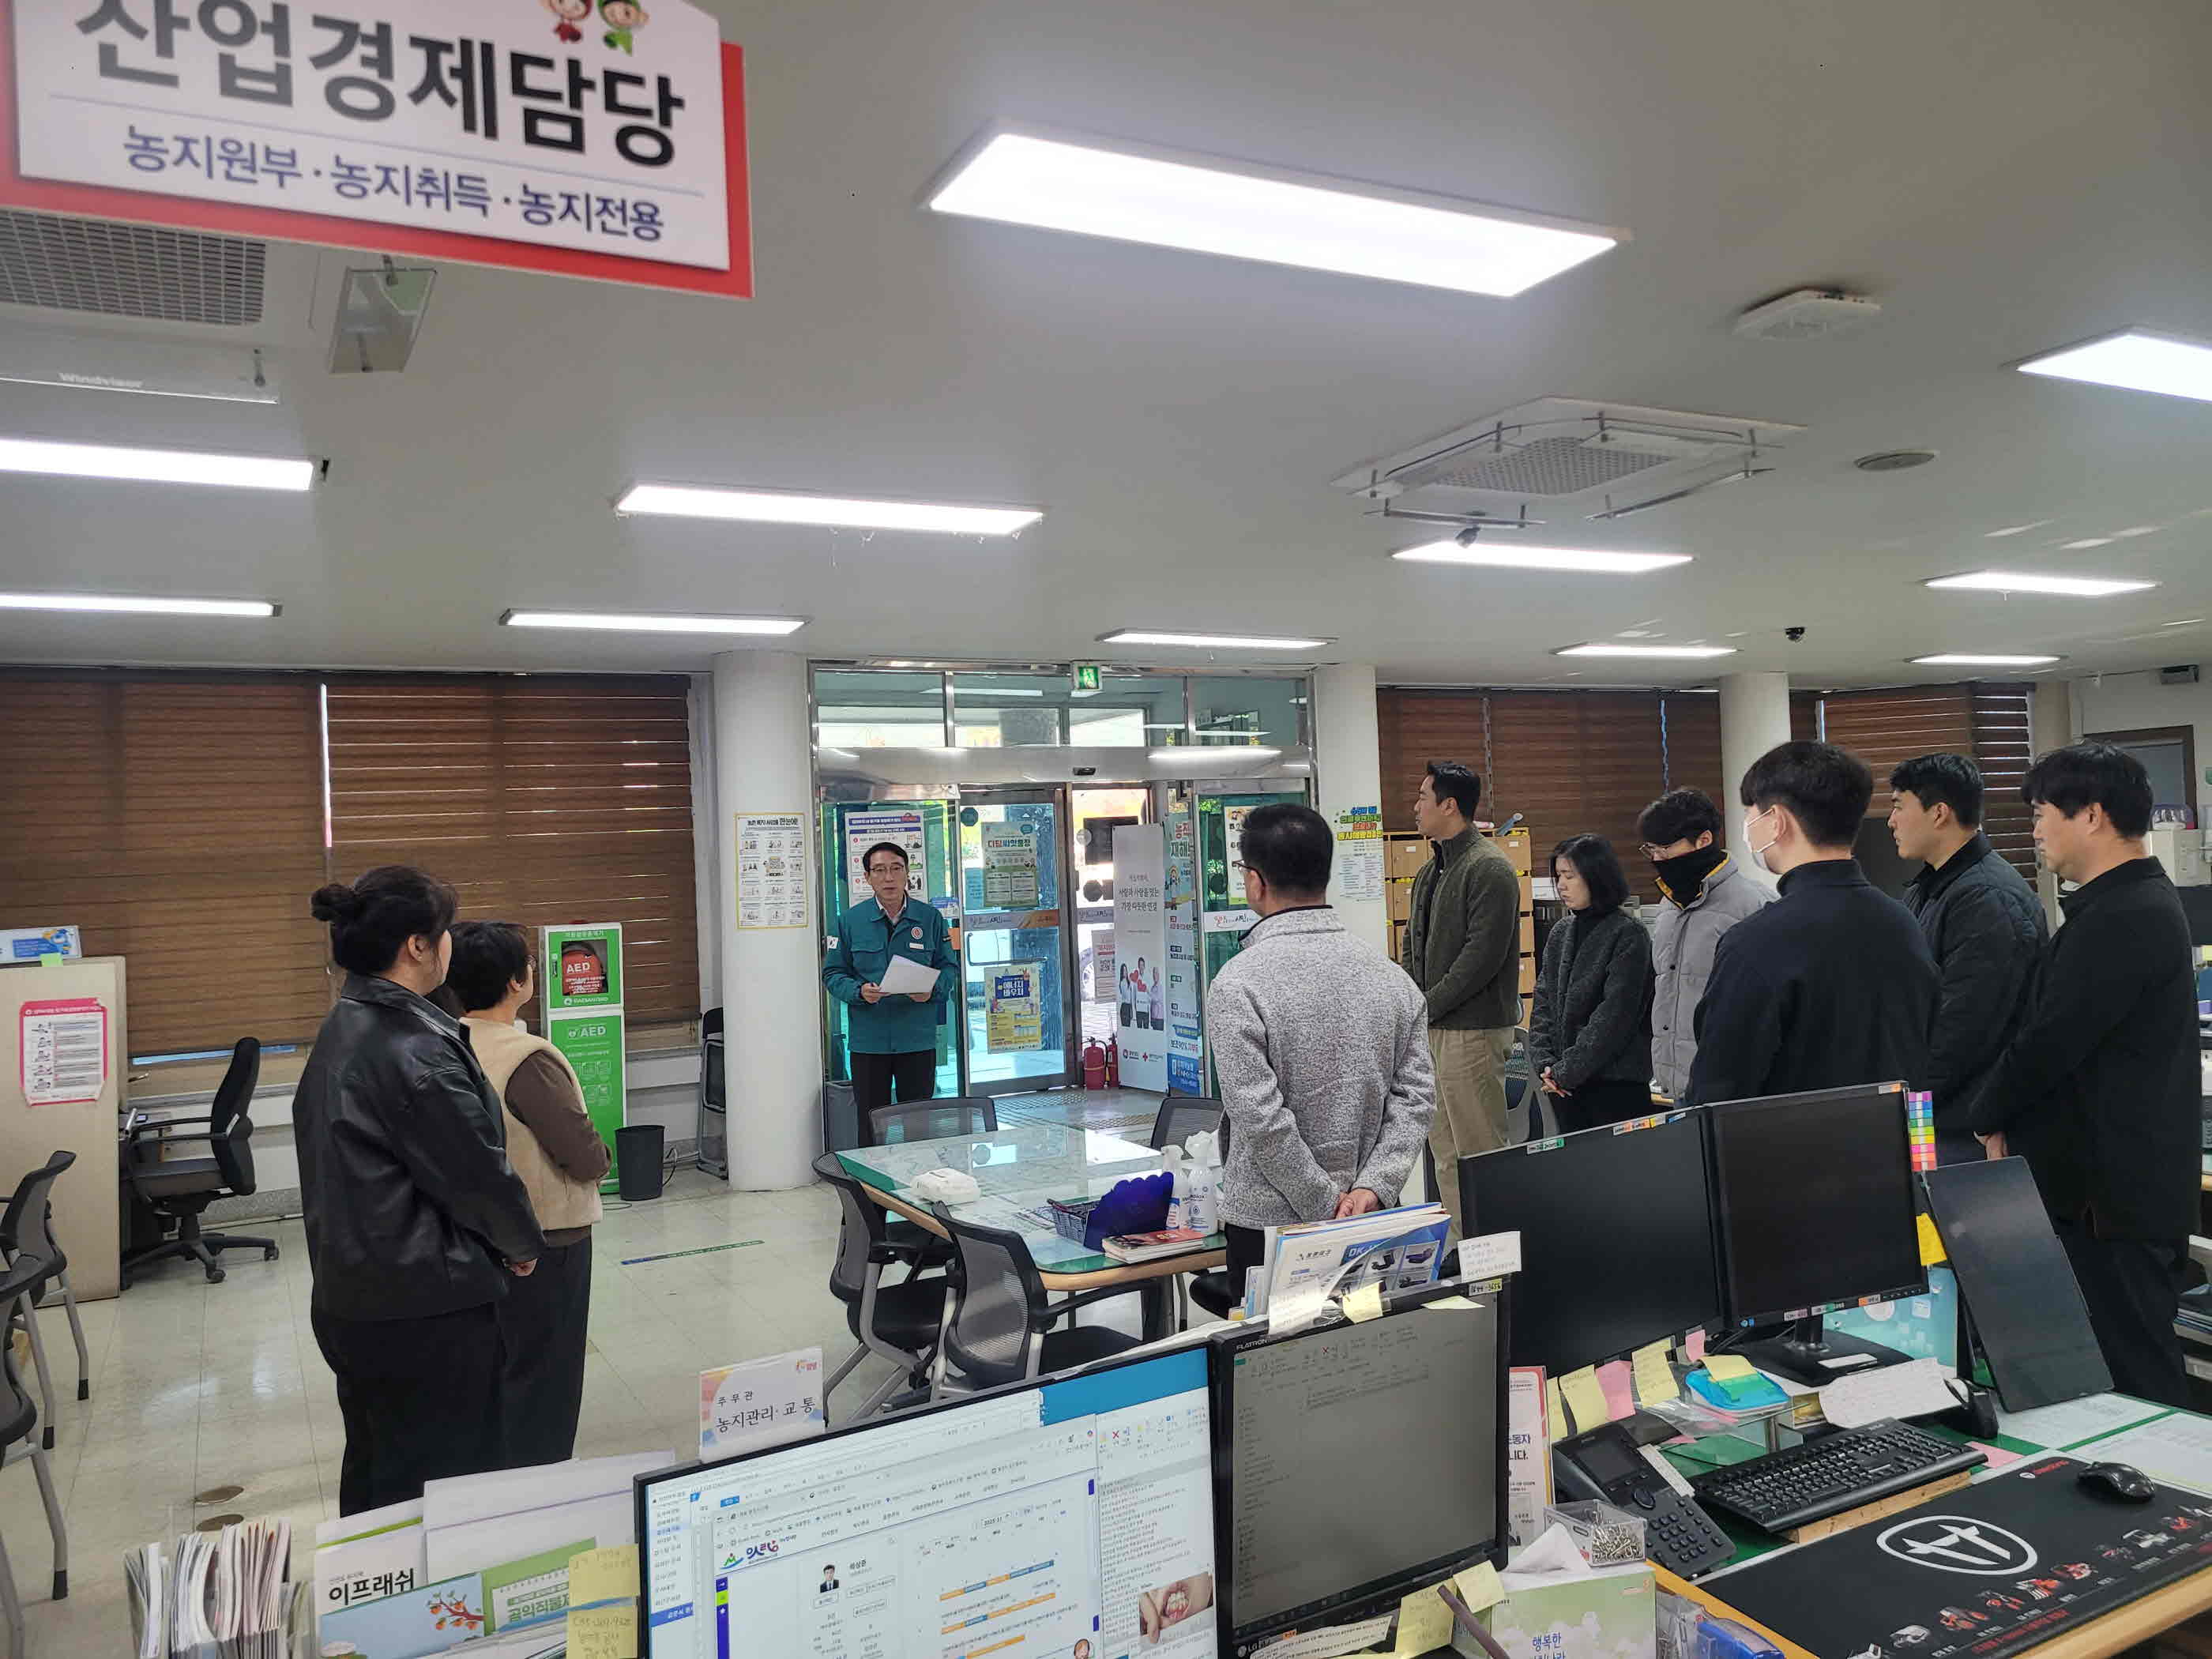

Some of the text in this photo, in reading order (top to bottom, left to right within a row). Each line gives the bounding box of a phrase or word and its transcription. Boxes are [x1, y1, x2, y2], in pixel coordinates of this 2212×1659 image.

[77, 0, 685, 167] 산업경제담당
[566, 962, 590, 973] AED
[581, 1025, 607, 1037] AED
[1236, 1338, 1268, 1350] FLATRON
[1509, 1450, 1529, 1461] 니다.
[329, 1567, 415, 1606] 이프래쉬
[1532, 1632, 1562, 1653] 행복한
